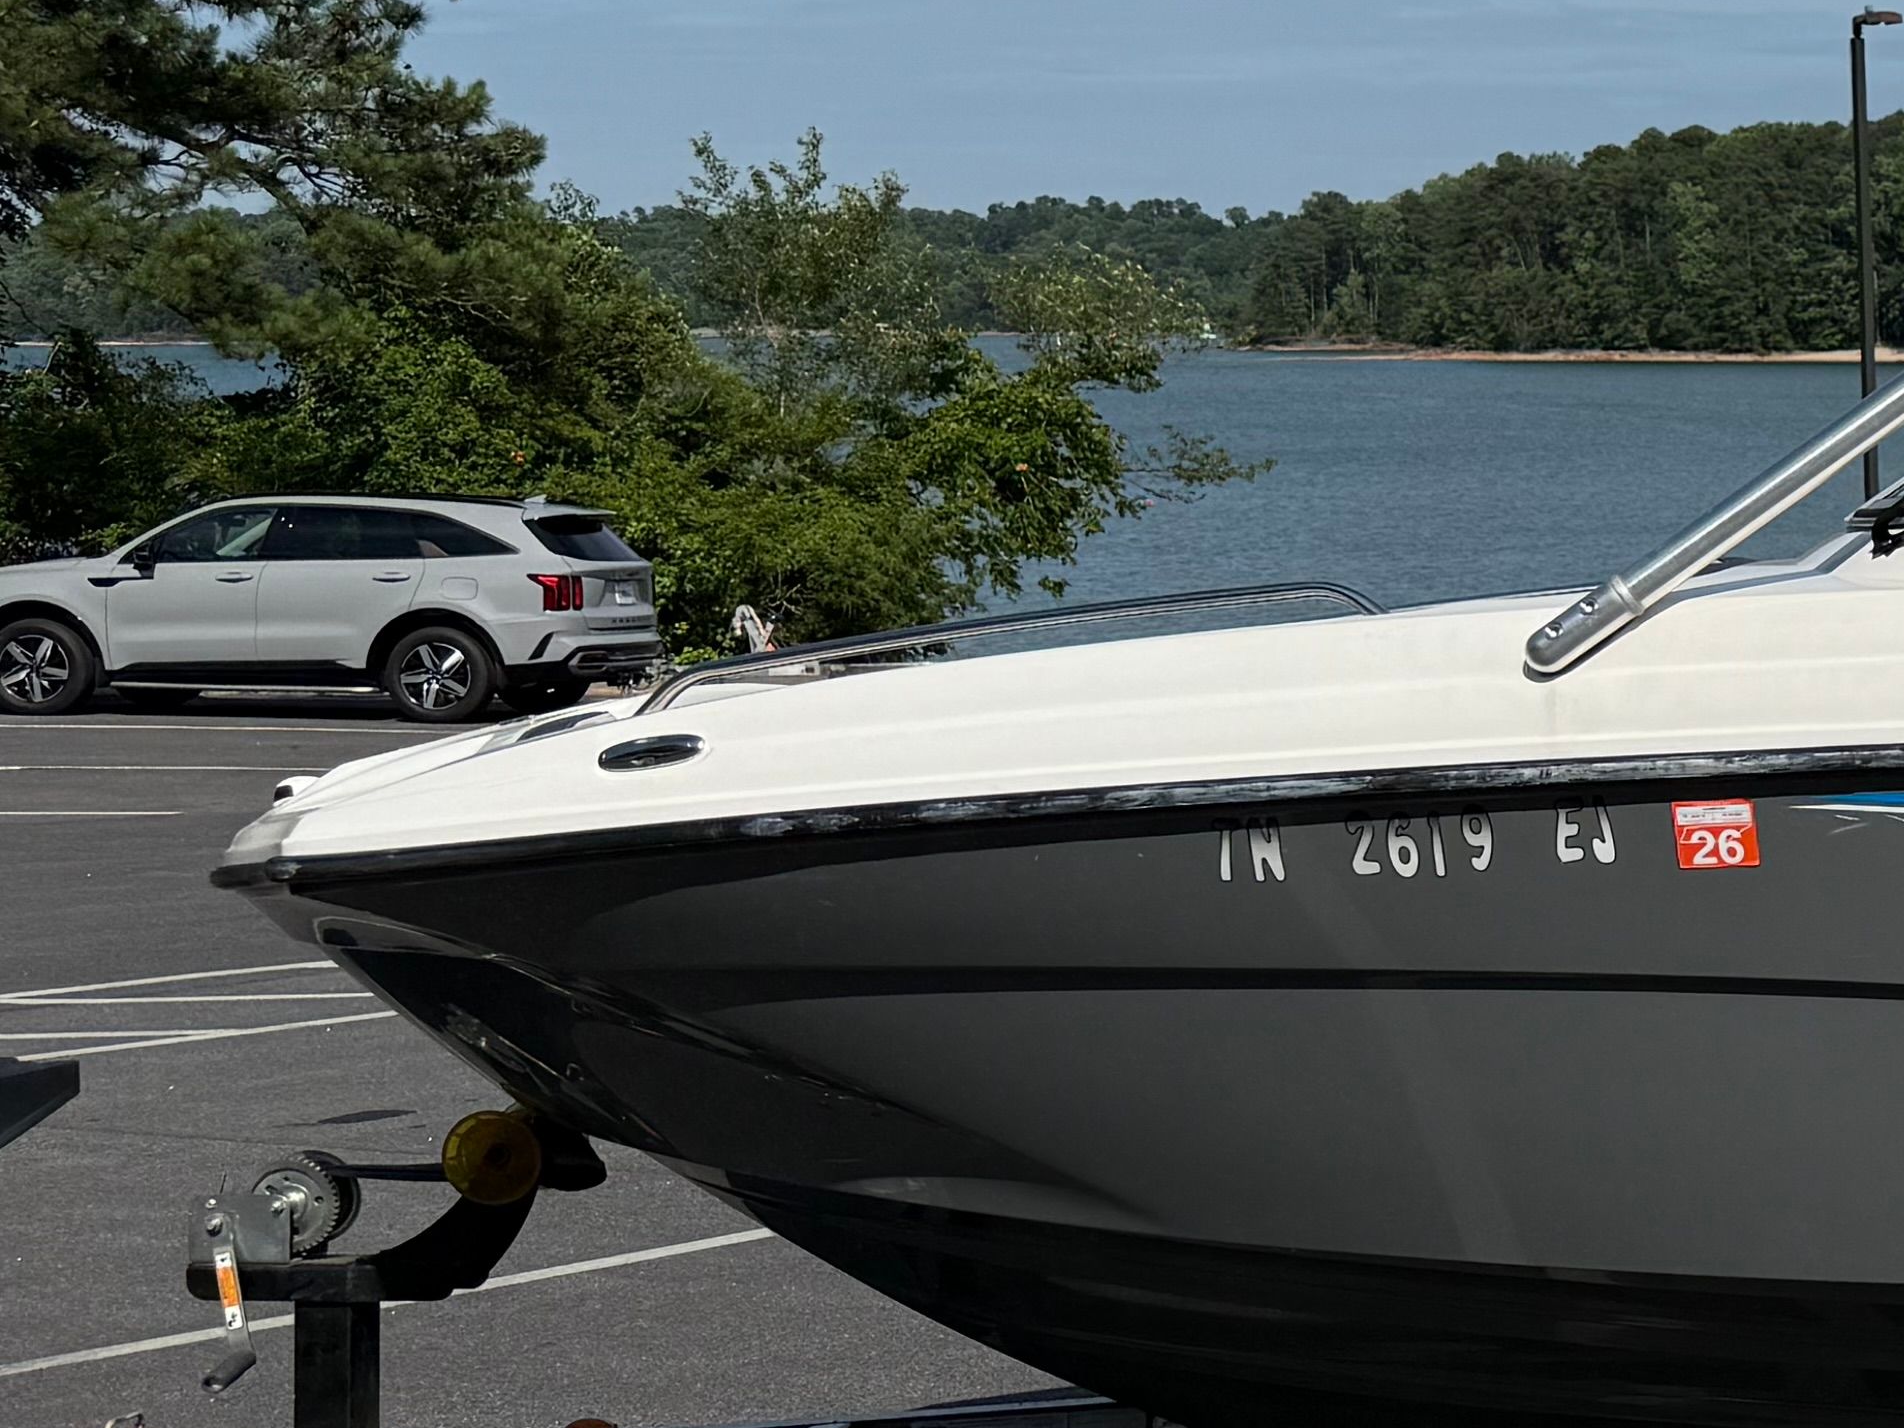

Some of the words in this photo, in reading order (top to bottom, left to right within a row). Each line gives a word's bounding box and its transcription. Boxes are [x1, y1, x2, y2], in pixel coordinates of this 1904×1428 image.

[1211, 816, 1286, 882] TN
[1345, 804, 1494, 878] 2619
[1554, 794, 1617, 864] EJ
[1690, 828, 1745, 865] 26
